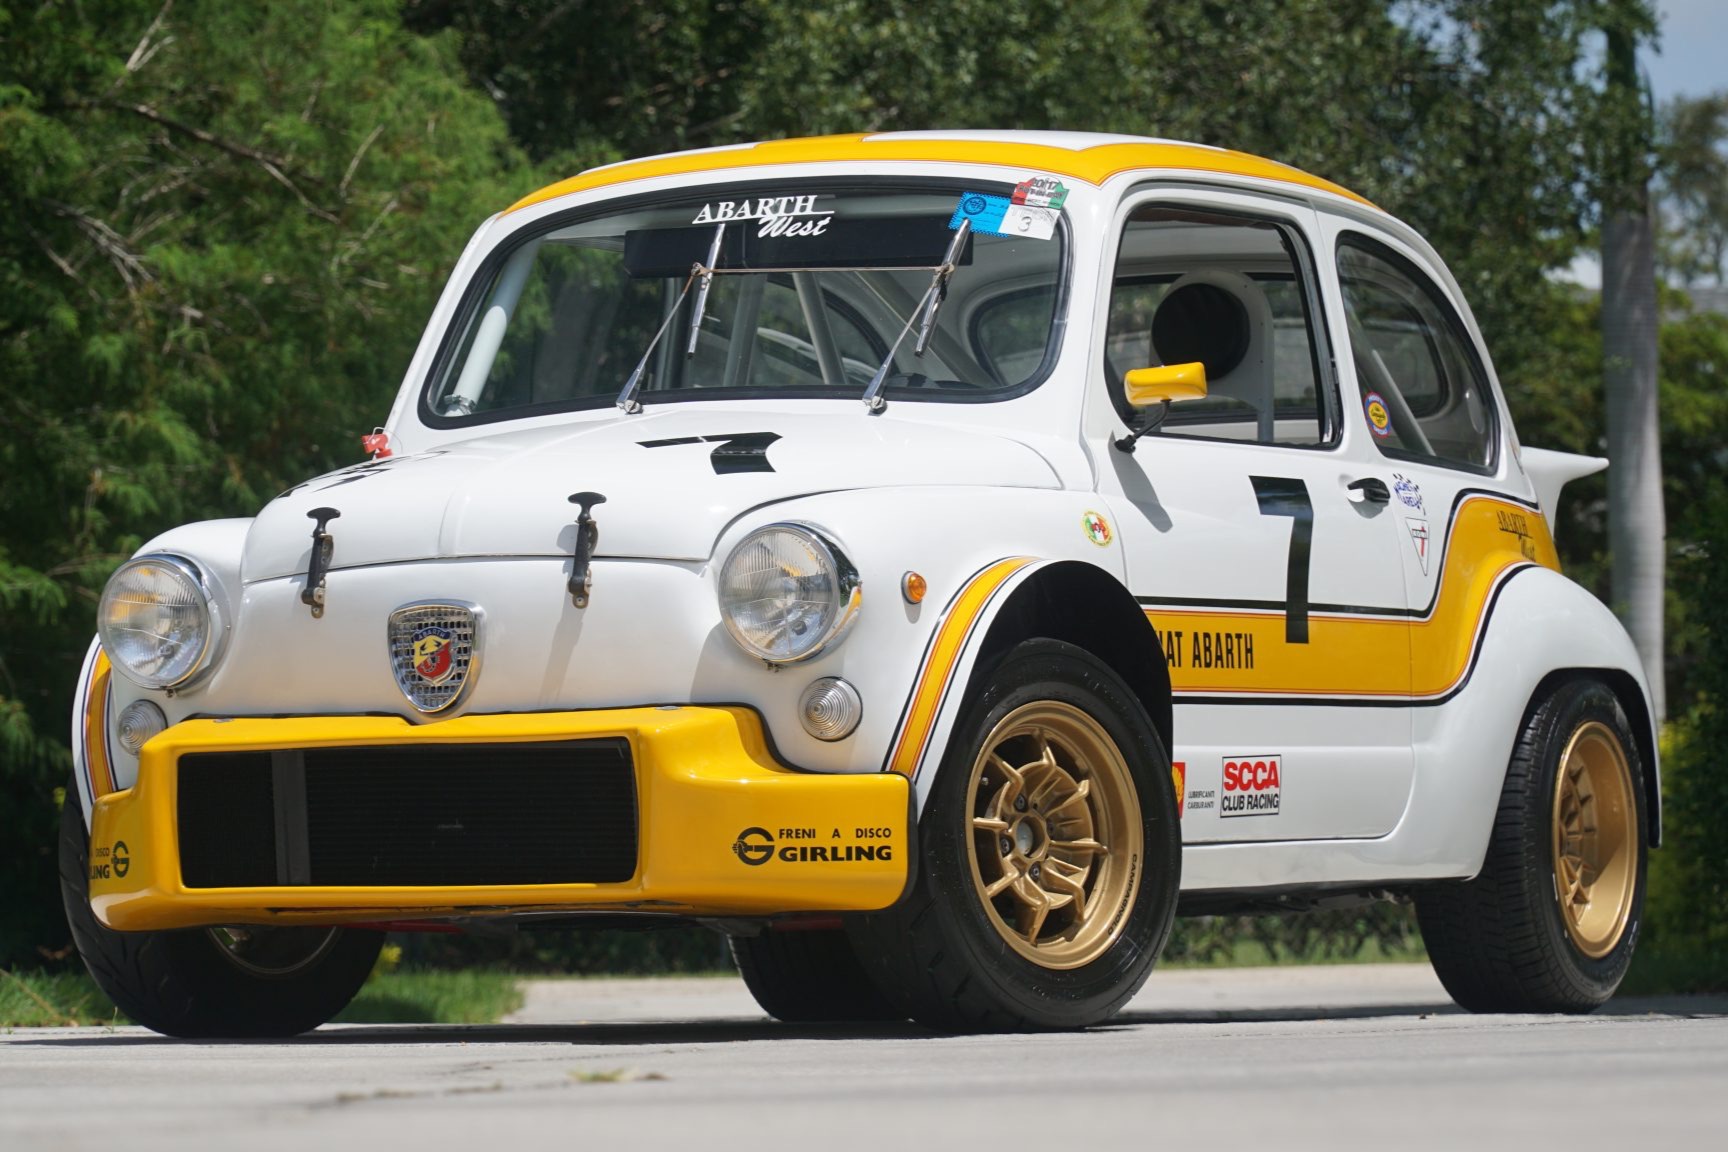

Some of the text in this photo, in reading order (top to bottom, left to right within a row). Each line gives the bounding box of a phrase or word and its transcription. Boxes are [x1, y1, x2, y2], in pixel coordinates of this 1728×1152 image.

[692, 195, 818, 224] ABARTH
[758, 216, 832, 238] West
[1017, 216, 1032, 232] 3
[1248, 475, 1314, 644] 7
[1192, 631, 1254, 669] ABARTH
[1223, 761, 1280, 791] SCCA
[1222, 794, 1280, 811] CLUB RACING
[778, 827, 892, 839] FRENI A DISCO
[778, 845, 892, 862] GIRLING
[1107, 853, 1138, 936] CAMPAGNOLO
